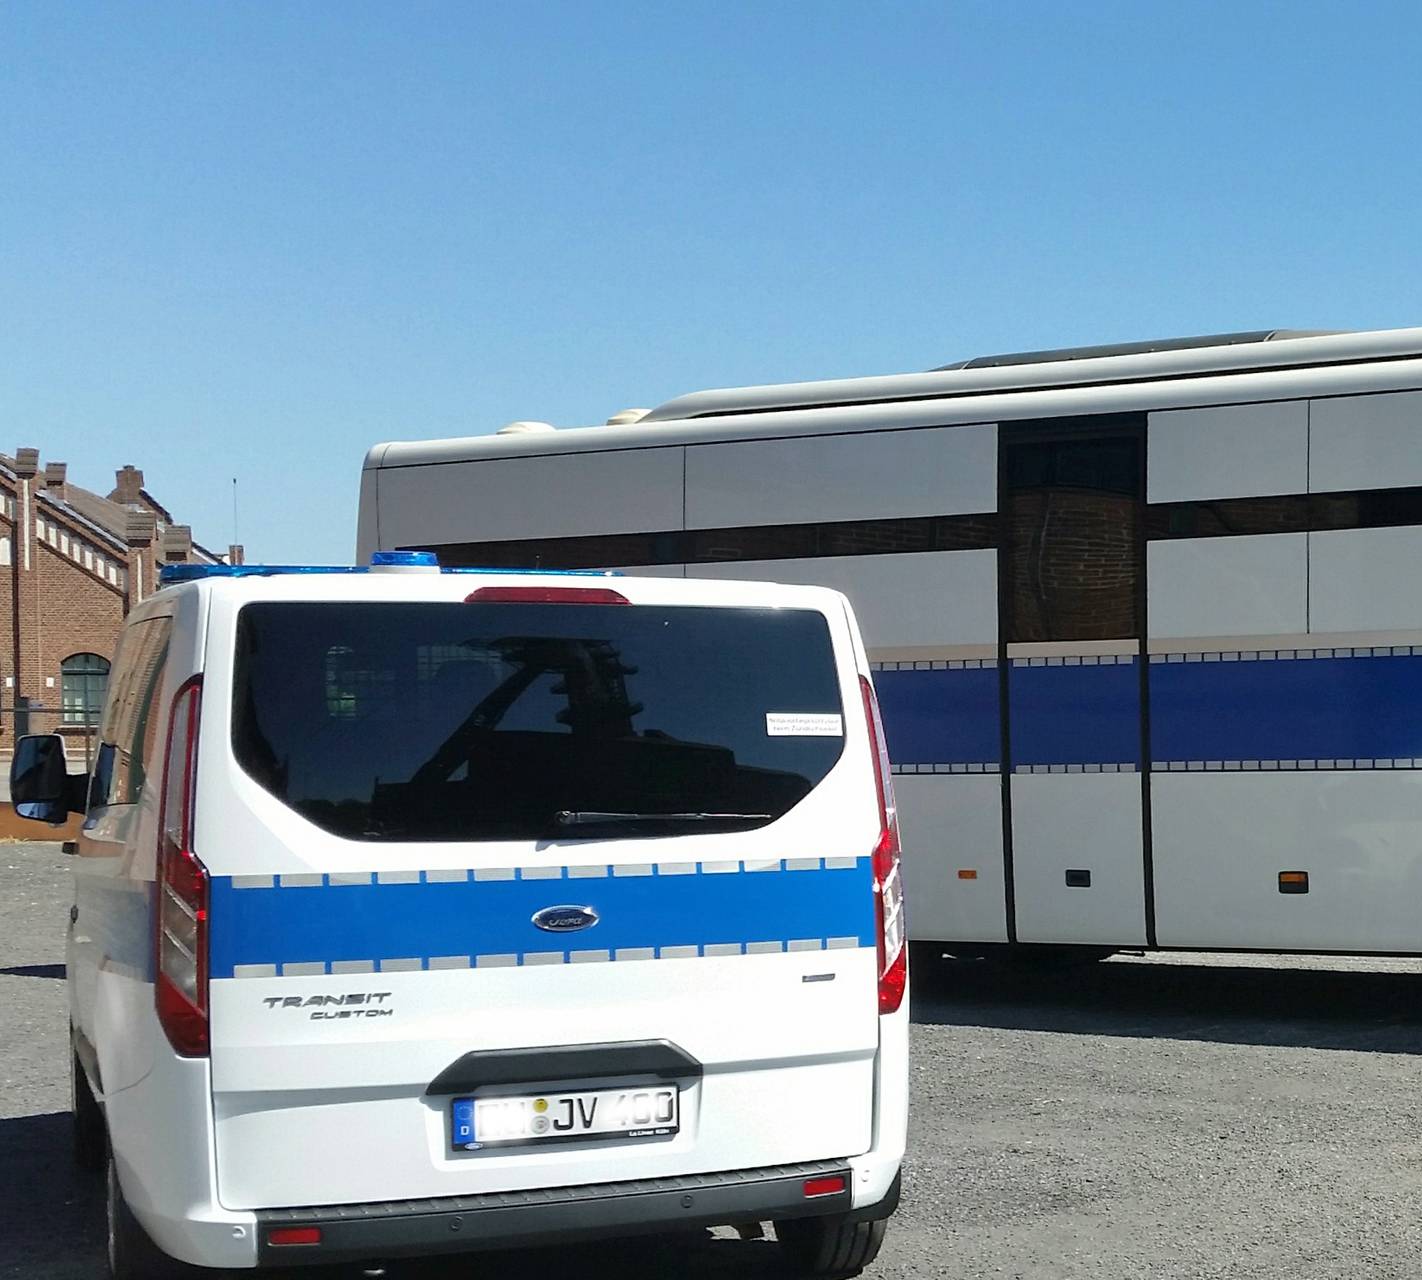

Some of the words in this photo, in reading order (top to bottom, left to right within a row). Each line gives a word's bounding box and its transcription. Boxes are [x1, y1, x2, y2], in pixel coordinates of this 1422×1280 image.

[262, 992, 393, 1009] TRANSIT
[310, 1009, 394, 1020] CUSTOM
[553, 1097, 598, 1131] JV
[460, 1125, 470, 1136] D
